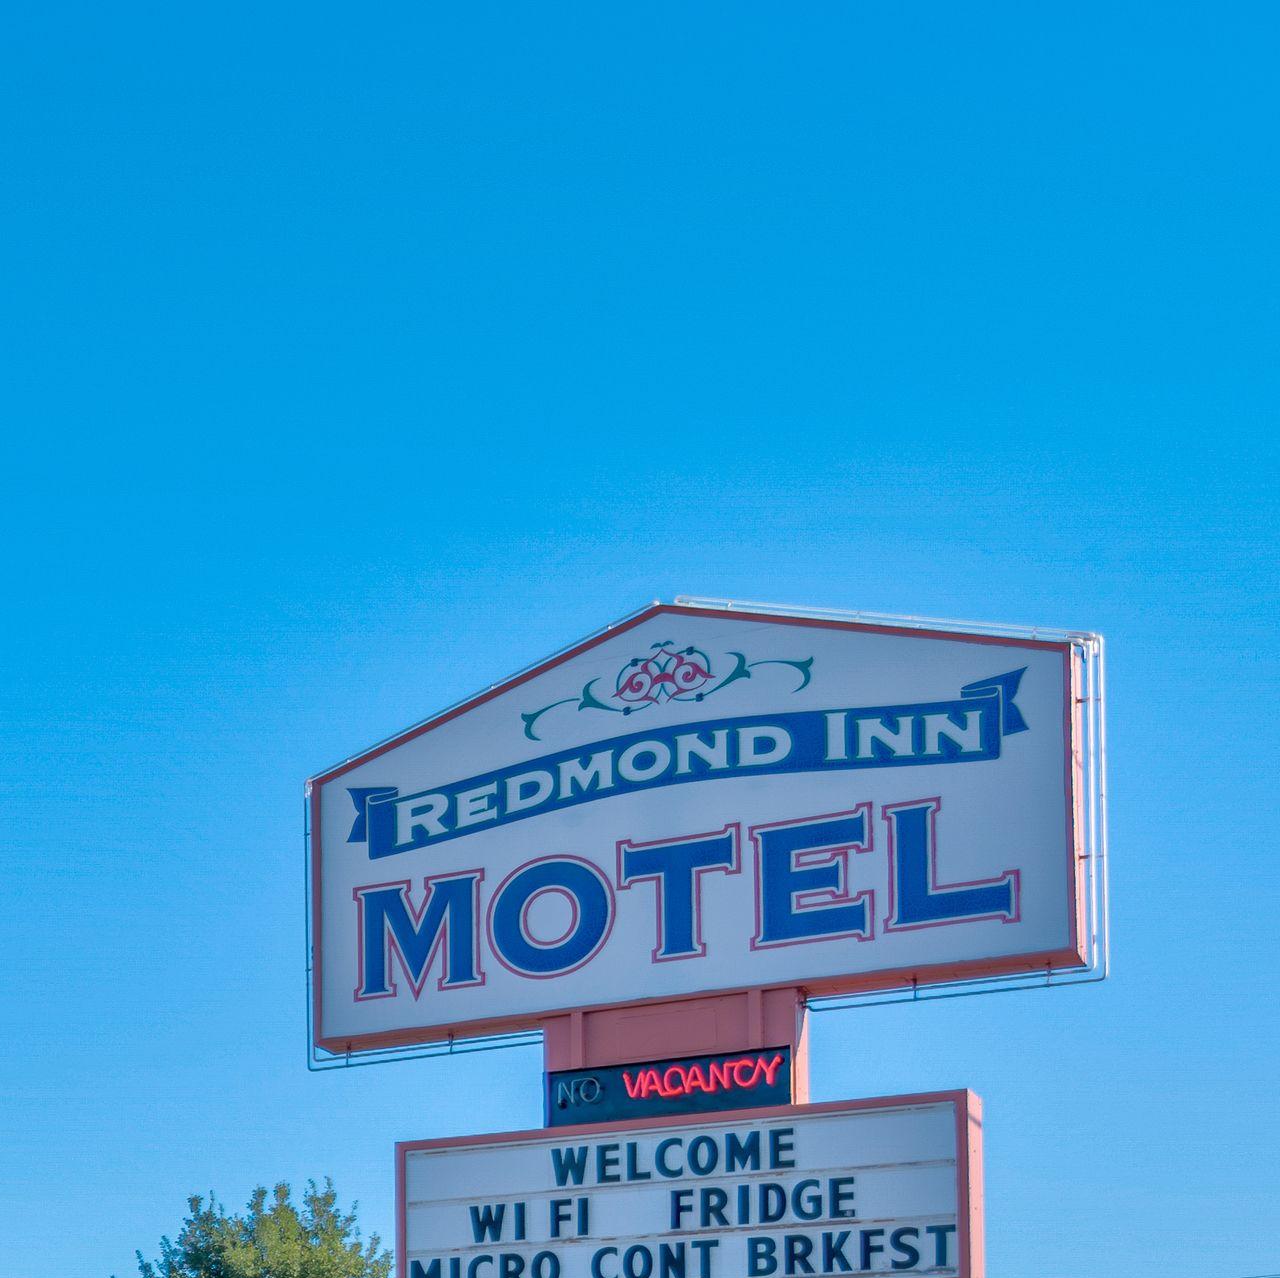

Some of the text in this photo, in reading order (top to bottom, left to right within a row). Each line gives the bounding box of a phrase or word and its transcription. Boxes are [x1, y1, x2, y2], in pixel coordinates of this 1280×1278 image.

[394, 710, 983, 846] REDMOND INN
[352, 796, 1021, 1002] MOTEL
[557, 1054, 785, 1104] NO VACANCY
[551, 1127, 795, 1187] WELCOME
[470, 1176, 857, 1243] WI FI FRIDGE
[747, 1224, 957, 1278] BRKFST
